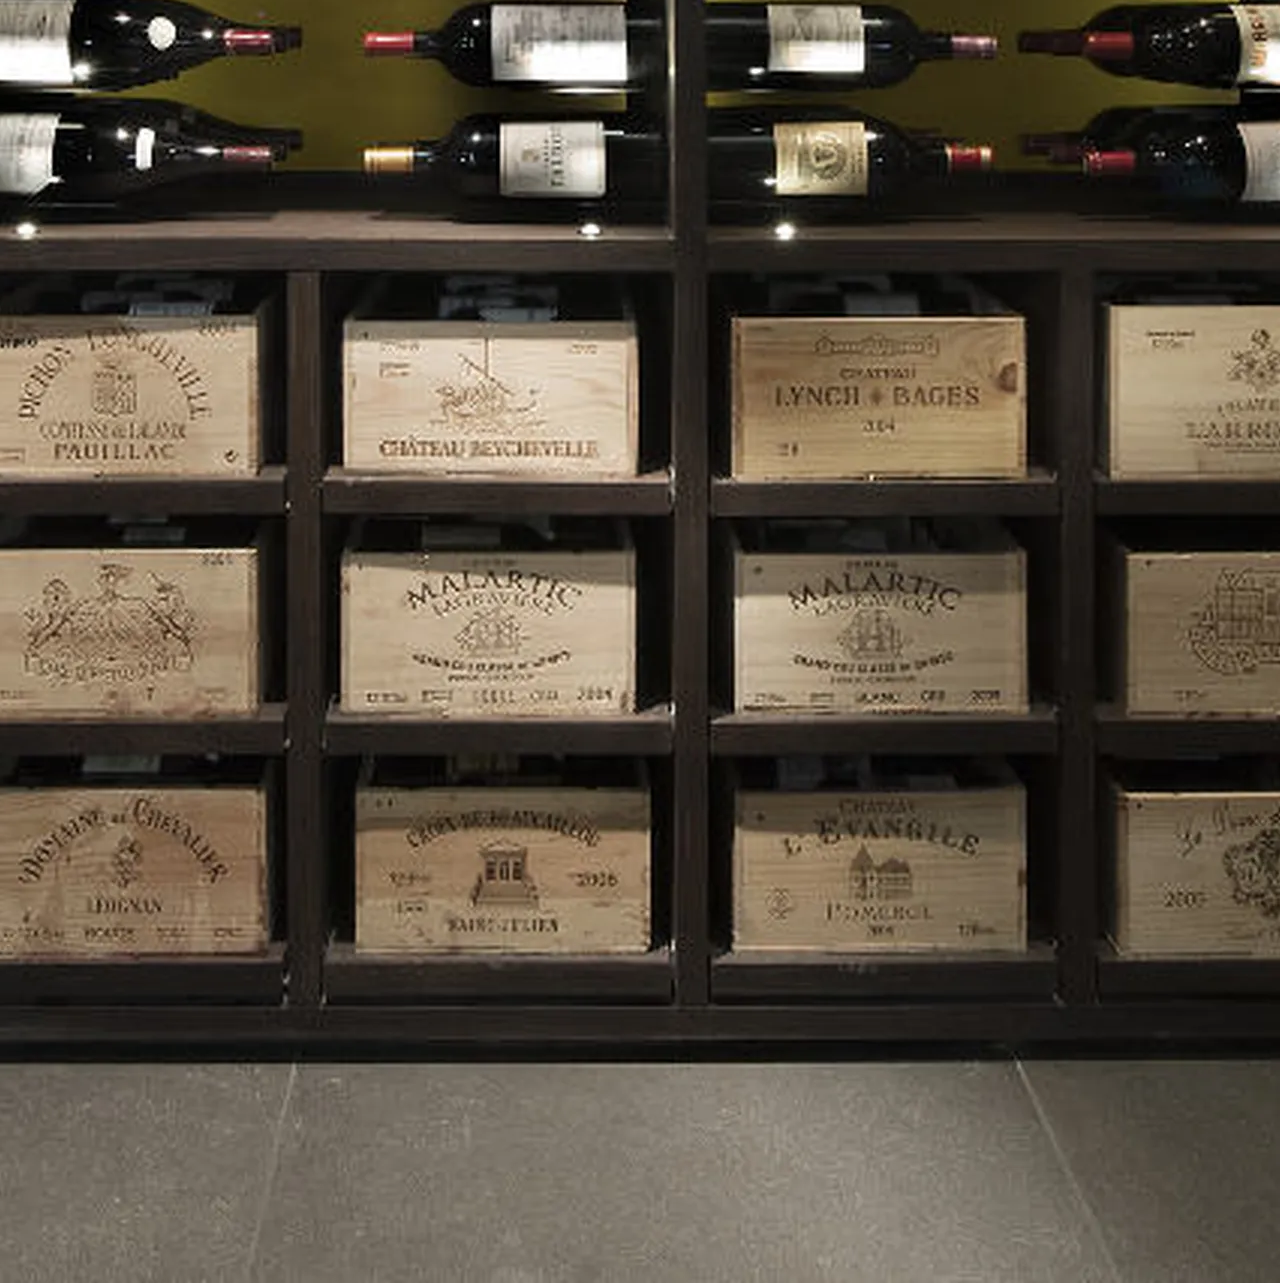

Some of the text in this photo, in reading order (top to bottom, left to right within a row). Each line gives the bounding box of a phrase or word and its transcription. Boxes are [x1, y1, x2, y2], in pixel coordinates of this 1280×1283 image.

[775, 385, 982, 407] LYNCH BAGES
[53, 443, 176, 461] PAUILLAC
[404, 569, 582, 611] MALARTIC
[787, 570, 964, 612] MALARTIC
